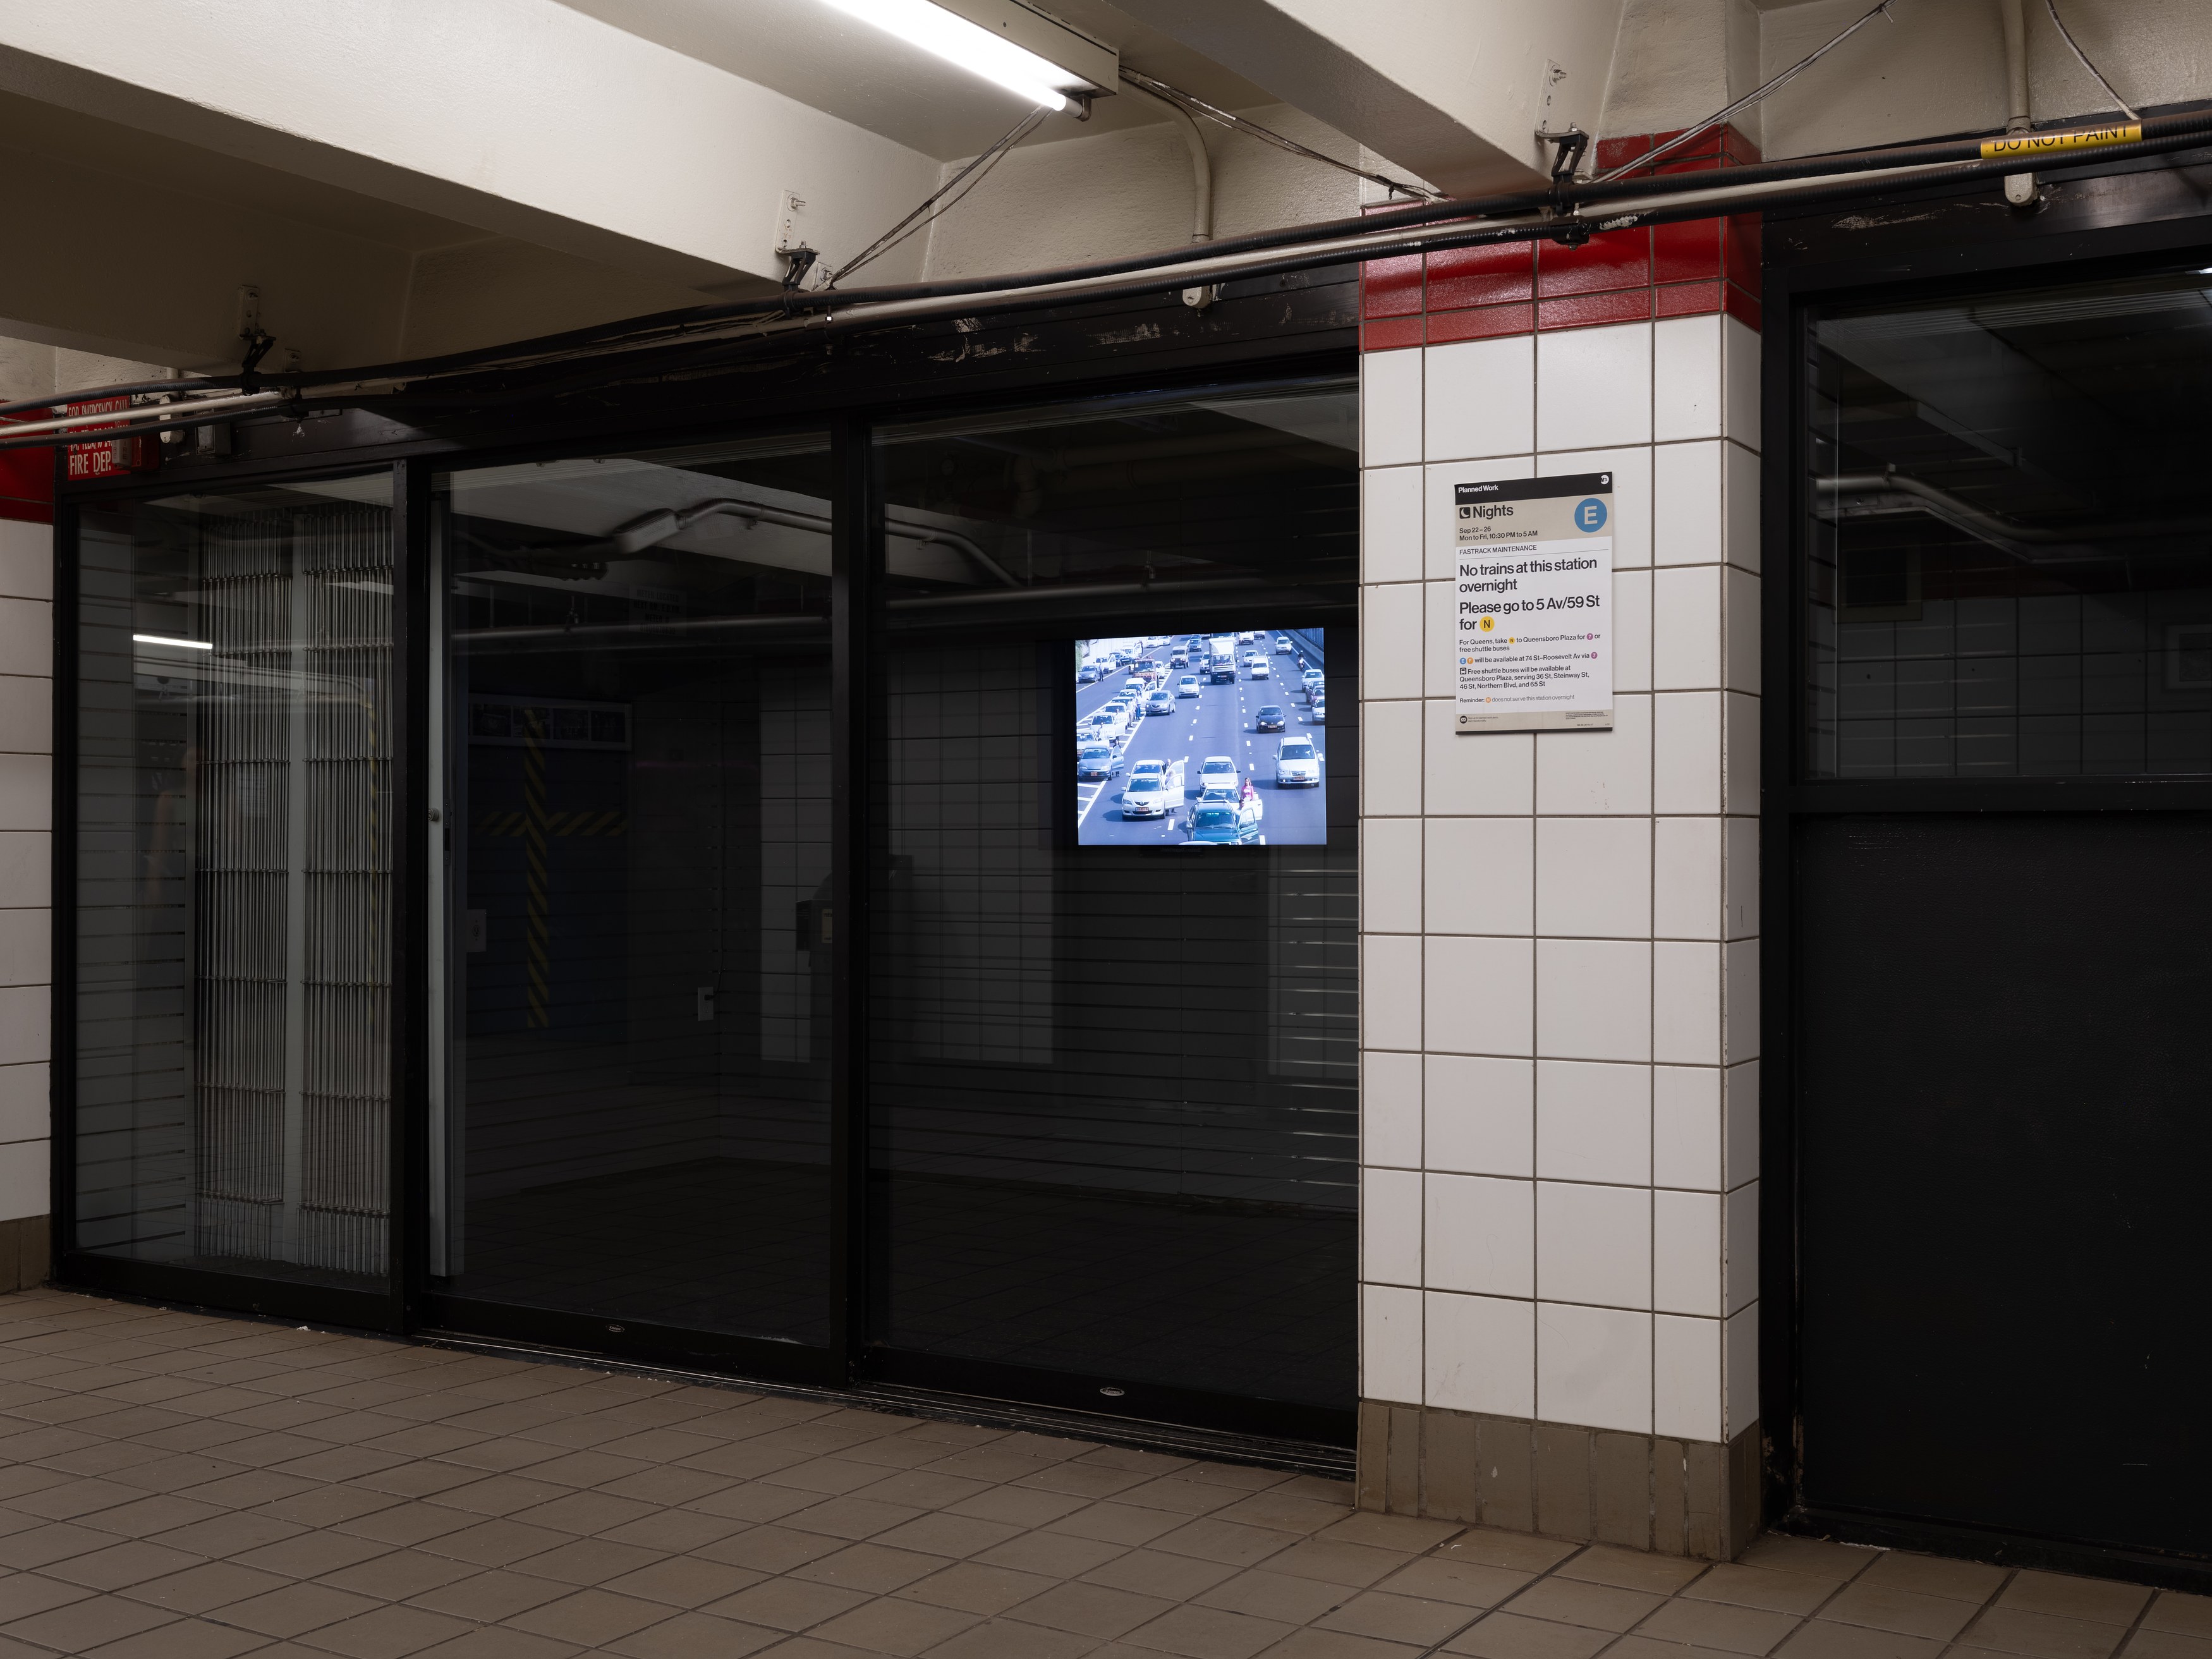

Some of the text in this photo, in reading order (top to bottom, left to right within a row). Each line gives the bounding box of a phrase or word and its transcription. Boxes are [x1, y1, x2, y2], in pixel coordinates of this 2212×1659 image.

[1994, 125, 2129, 152] DO NOT PAINT
[70, 451, 111, 475] FIRE DEP.
[1473, 505, 1514, 520] Nights
[1584, 506, 1597, 525] E
[1460, 558, 1597, 576] No trains at this station
[1459, 579, 1517, 593] overnight
[1460, 595, 1600, 614] Please go to 5 Av/59 St
[1459, 619, 1490, 630] for N
